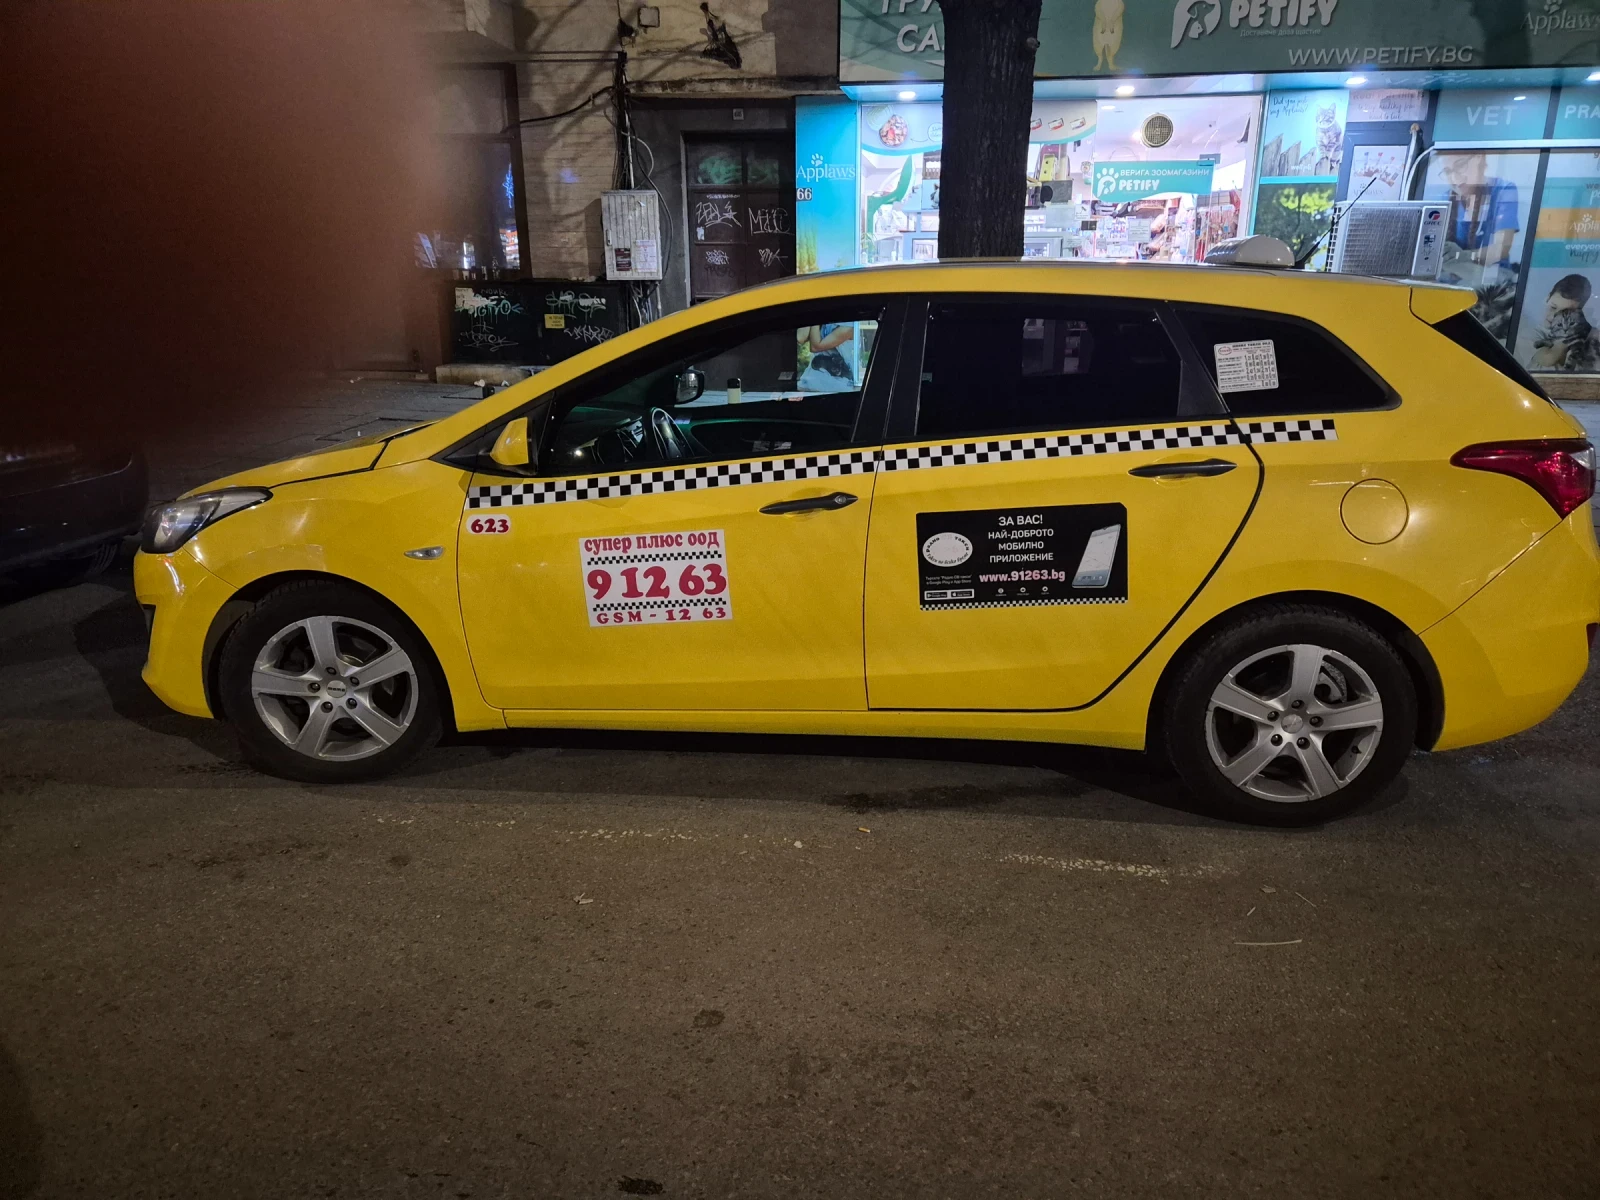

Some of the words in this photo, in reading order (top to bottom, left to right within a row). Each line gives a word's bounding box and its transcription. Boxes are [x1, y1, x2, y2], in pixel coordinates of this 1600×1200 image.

[1230, 0, 1338, 28] PETIFY
[896, 23, 944, 52] СА
[1288, 46, 1473, 66] WWW.PETIFY.BG
[1466, 106, 1518, 126] VET
[796, 164, 856, 182] Applaws
[1118, 179, 1160, 190] PETIFY
[796, 188, 812, 200] 66
[471, 518, 509, 533] 623
[998, 516, 1014, 526] ЗА
[1016, 514, 1042, 525] ВАС!
[636, 533, 682, 549] плюс
[988, 528, 1054, 540] НАЙ-ДОБРОТО
[998, 541, 1044, 551] МОБИЛНО
[990, 552, 1054, 563] ПРИЛОЖЕНИЕ
[979, 568, 1066, 582] www.91263.bg
[596, 611, 643, 624] GSM
[665, 609, 692, 621] 12
[702, 608, 726, 619] 63
